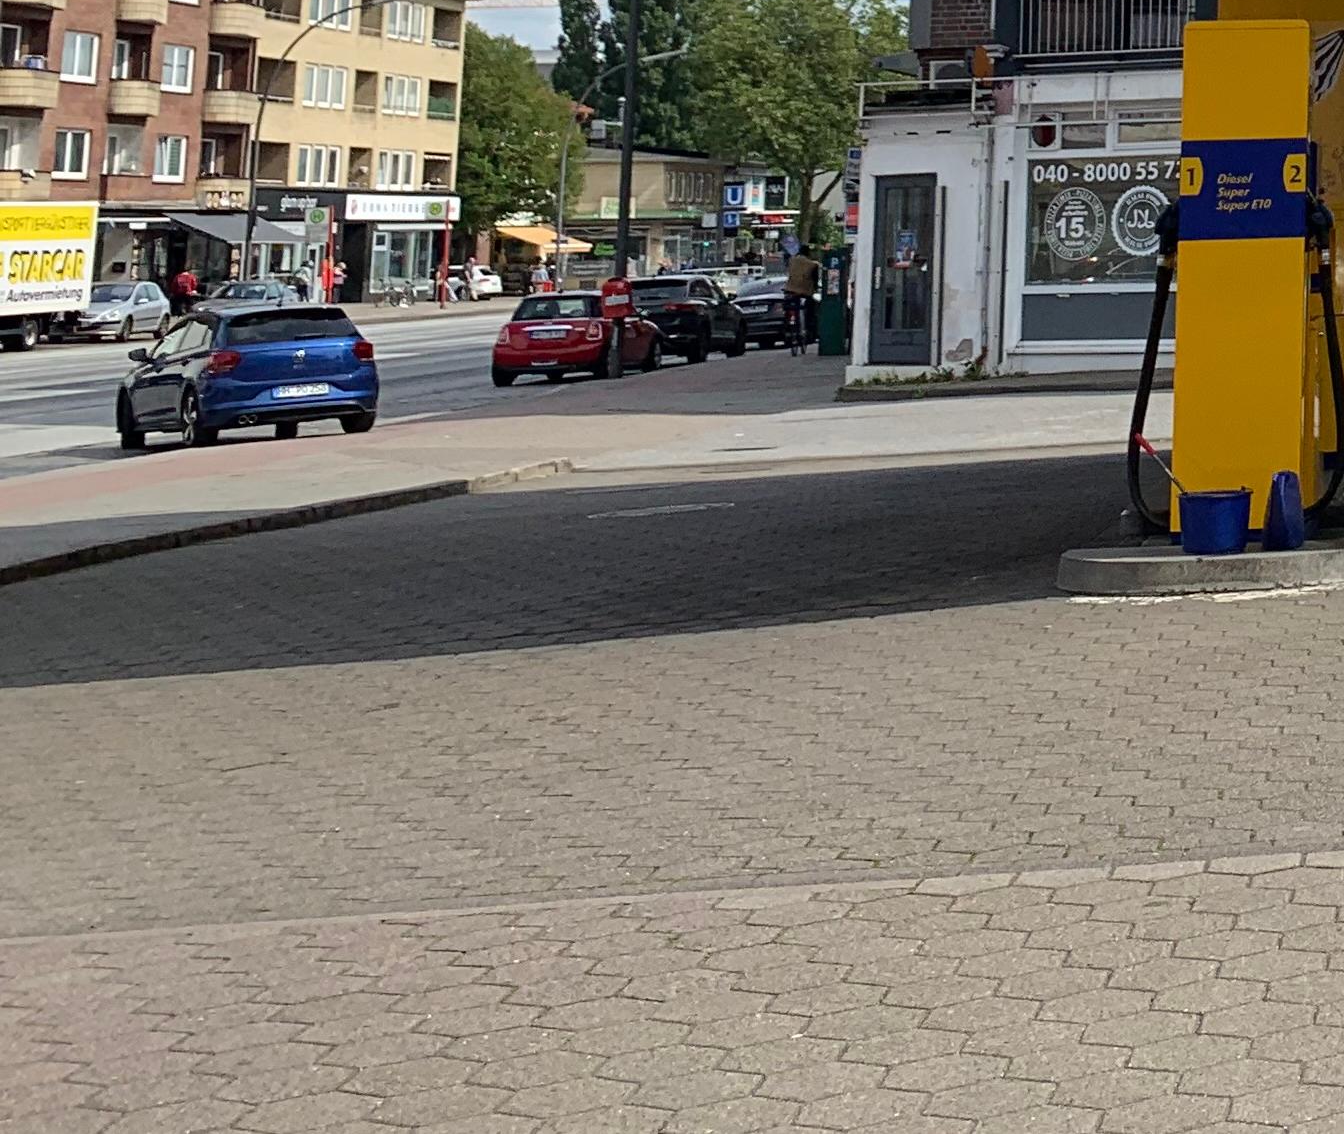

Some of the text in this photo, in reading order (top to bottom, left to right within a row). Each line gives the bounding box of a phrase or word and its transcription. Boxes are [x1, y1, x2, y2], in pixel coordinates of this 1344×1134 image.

[1033, 165, 1068, 182] 040
[1083, 163, 1130, 182] 8000
[1135, 161, 1159, 181] 55
[1186, 168, 1195, 186] 1
[1217, 172, 1253, 185] Diesel
[1289, 165, 1302, 183] 2
[727, 187, 743, 205] U
[1217, 187, 1250, 201] Super
[1216, 199, 1272, 214] Super E10
[8, 249, 86, 284] STARCAR
[7, 286, 83, 304] Autovermietung
